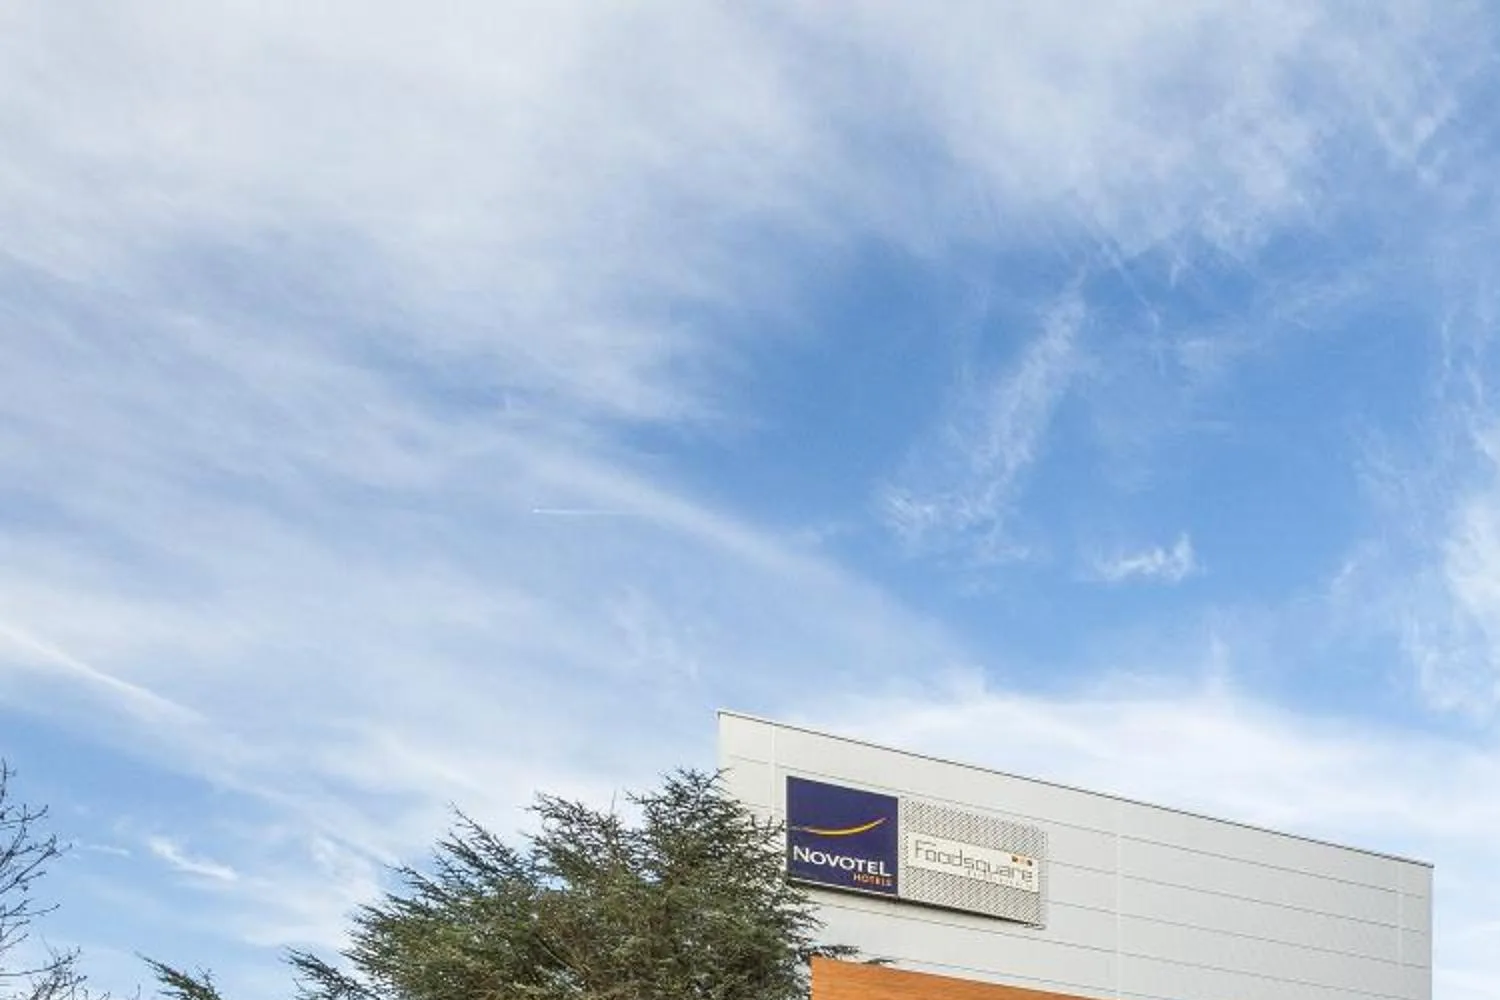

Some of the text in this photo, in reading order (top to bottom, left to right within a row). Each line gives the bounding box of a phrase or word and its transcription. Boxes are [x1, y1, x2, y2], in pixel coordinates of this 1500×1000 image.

[792, 845, 893, 877] NOVOTEL
[915, 839, 1034, 882] Foodsquare
[853, 872, 893, 887] HOTELS
